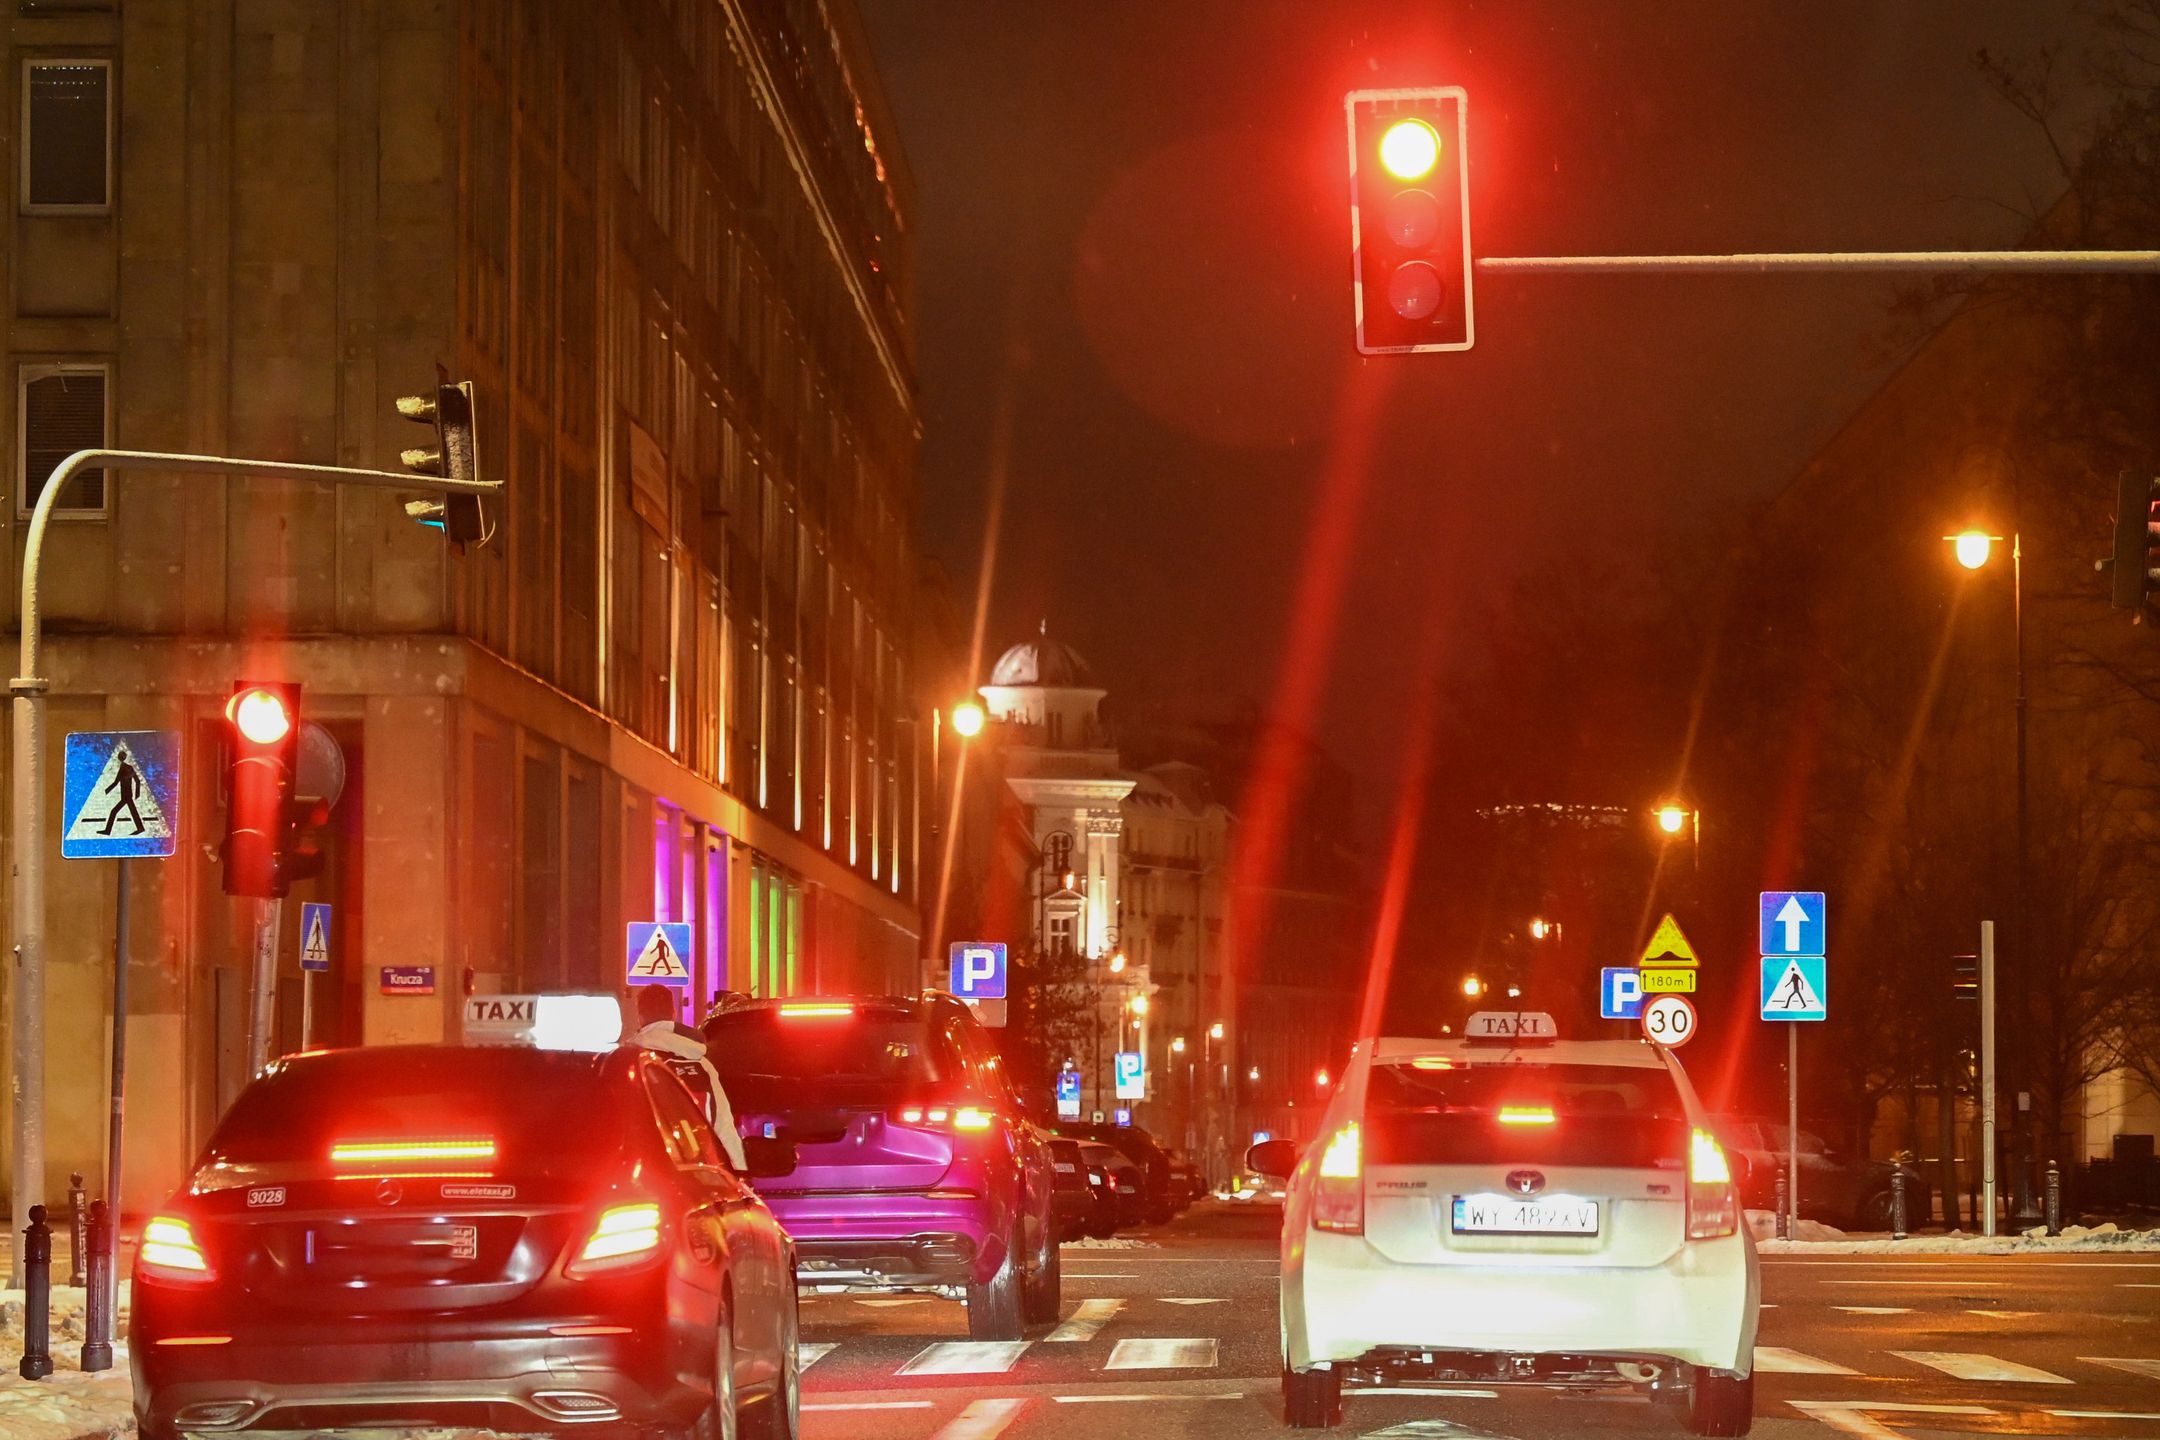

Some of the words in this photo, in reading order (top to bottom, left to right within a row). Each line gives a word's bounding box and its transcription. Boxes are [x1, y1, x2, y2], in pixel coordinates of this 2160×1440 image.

[390, 974, 423, 985] Krucza
[963, 949, 995, 992] P
[1613, 973, 1643, 1013] P
[473, 1001, 534, 1020] TAXI
[1482, 1018, 1539, 1034] TAXI
[1651, 1009, 1688, 1034] 30
[250, 1190, 283, 1204] 3028
[1472, 1207, 1501, 1226] WY
